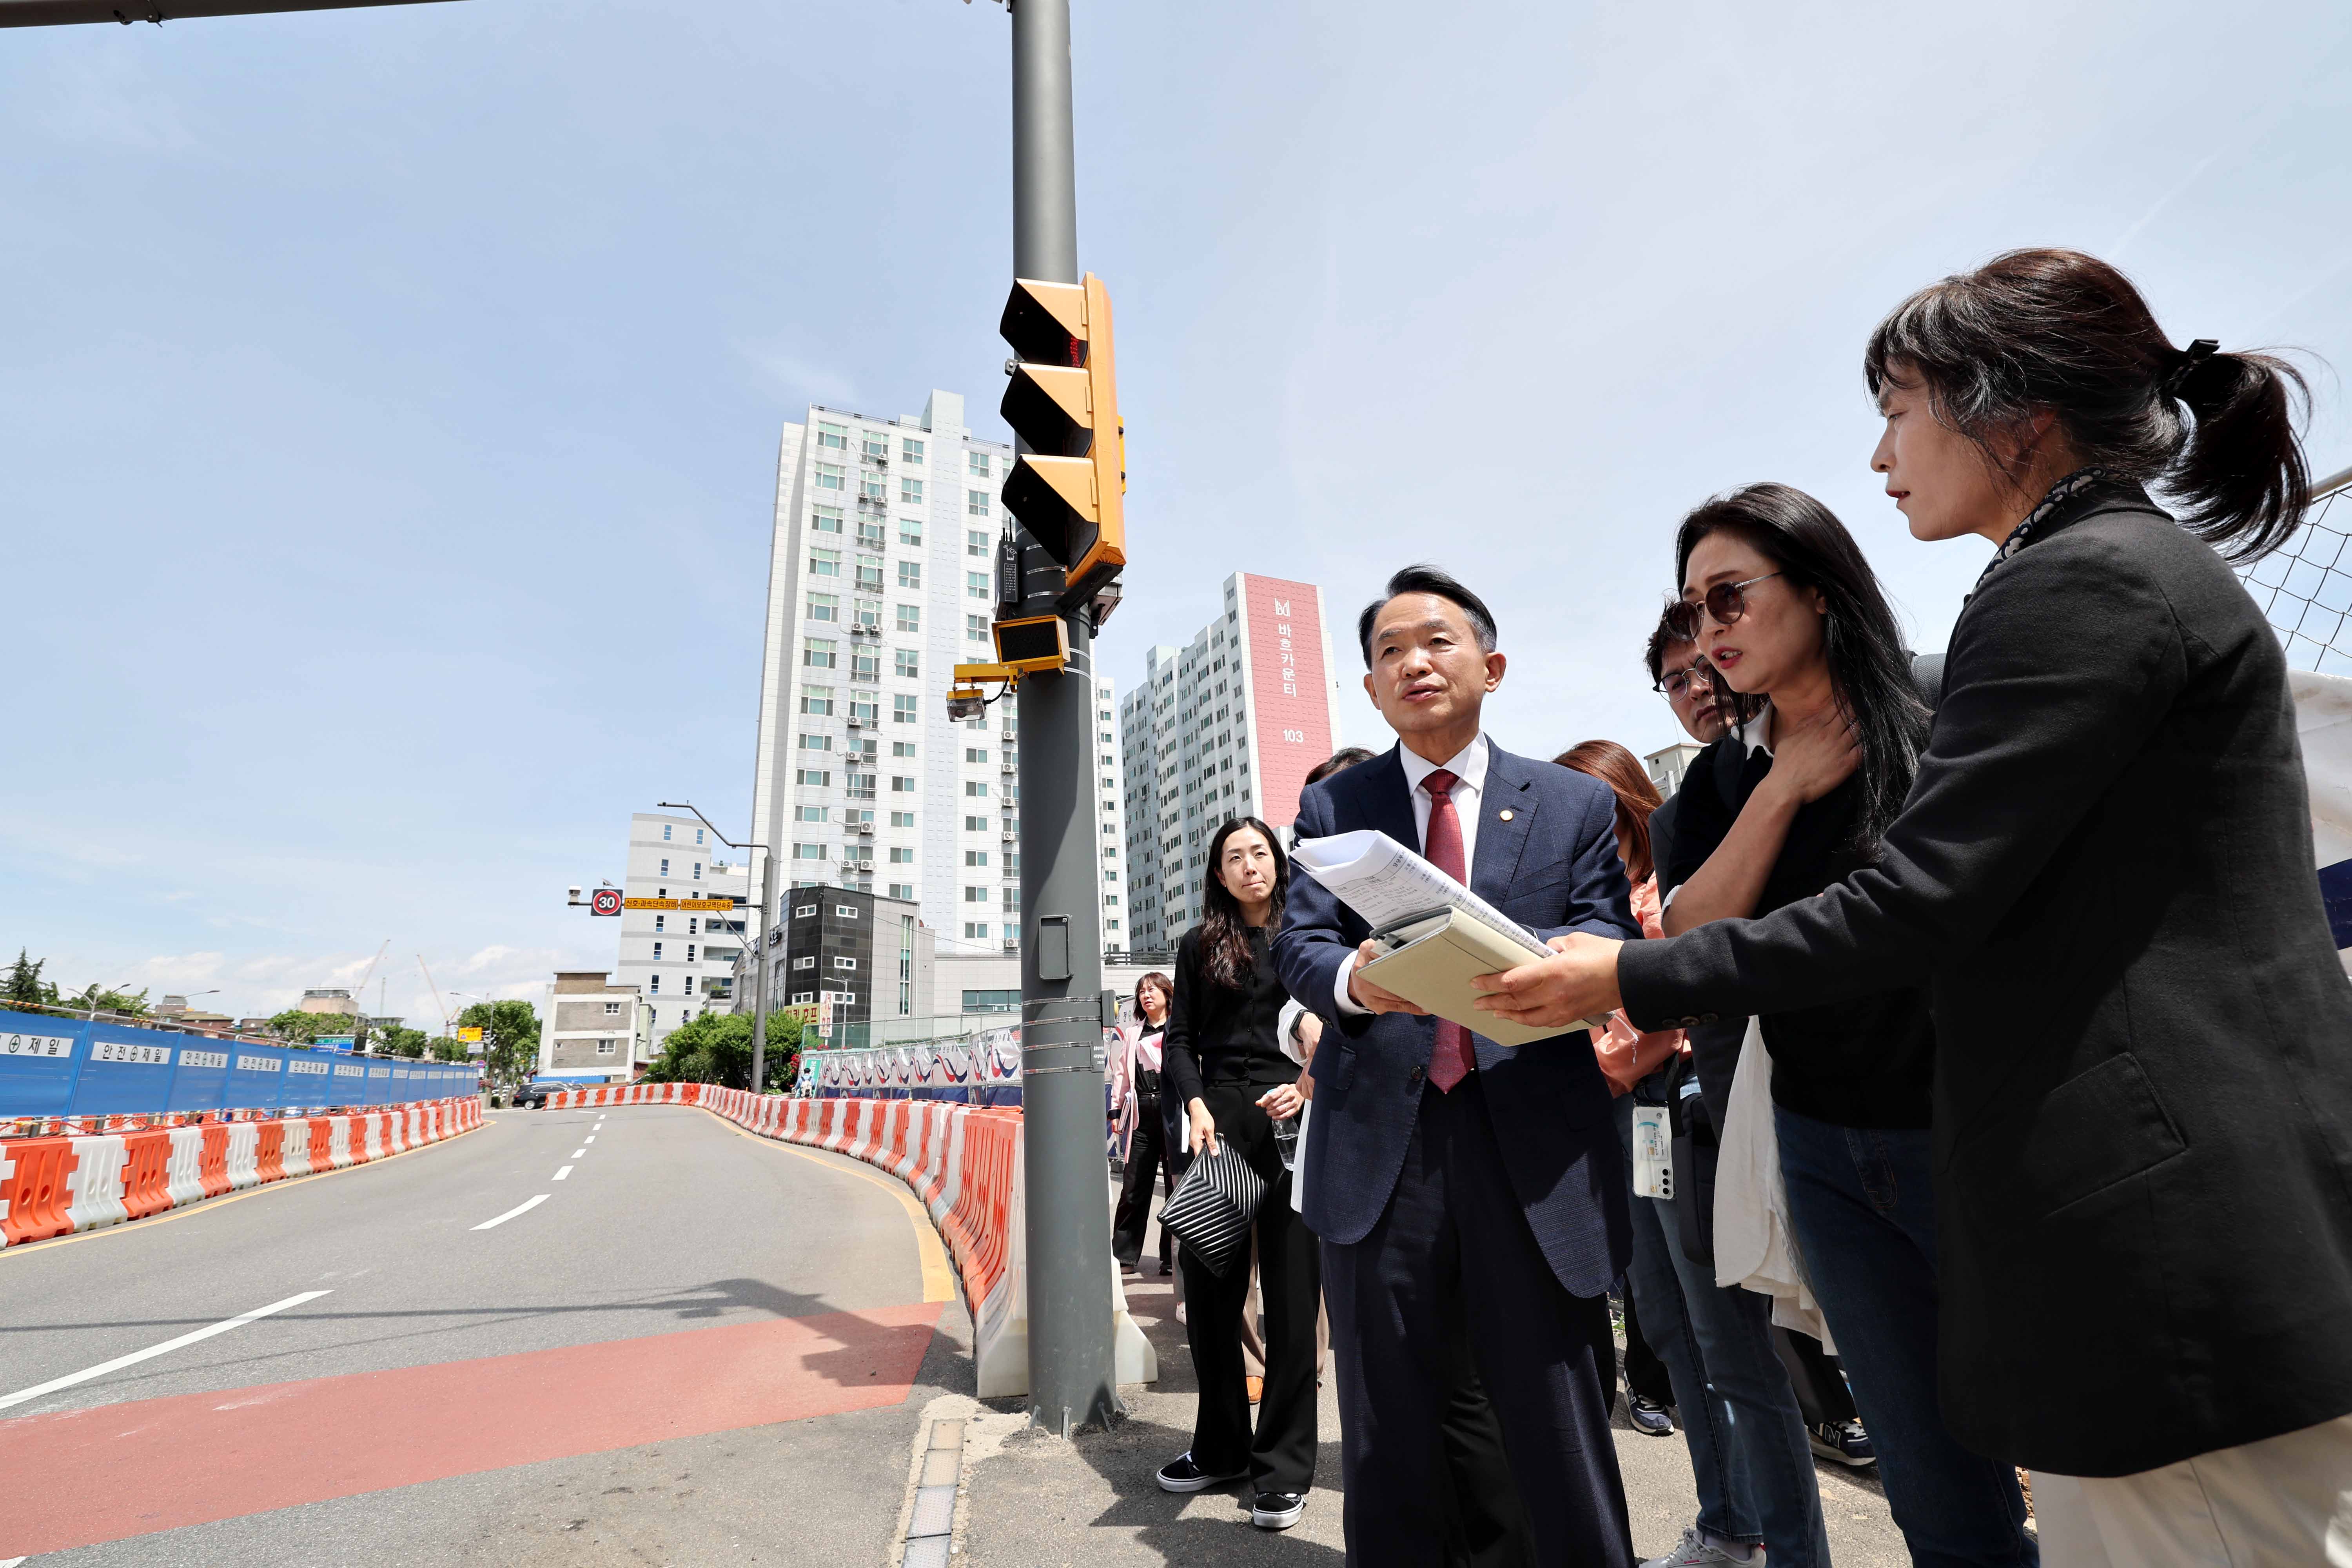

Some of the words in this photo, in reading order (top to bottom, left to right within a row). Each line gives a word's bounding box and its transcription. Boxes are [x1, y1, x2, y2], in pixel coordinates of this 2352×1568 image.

[1278, 623, 1297, 697] 바흐카운티
[1283, 729, 1304, 743] 103
[599, 897, 615, 908] 30
[626, 900, 677, 908] 신호·과속단속장비
[28, 1038, 60, 1055] 제일
[102, 1045, 126, 1060] 안전
[142, 1048, 163, 1062] 제일
